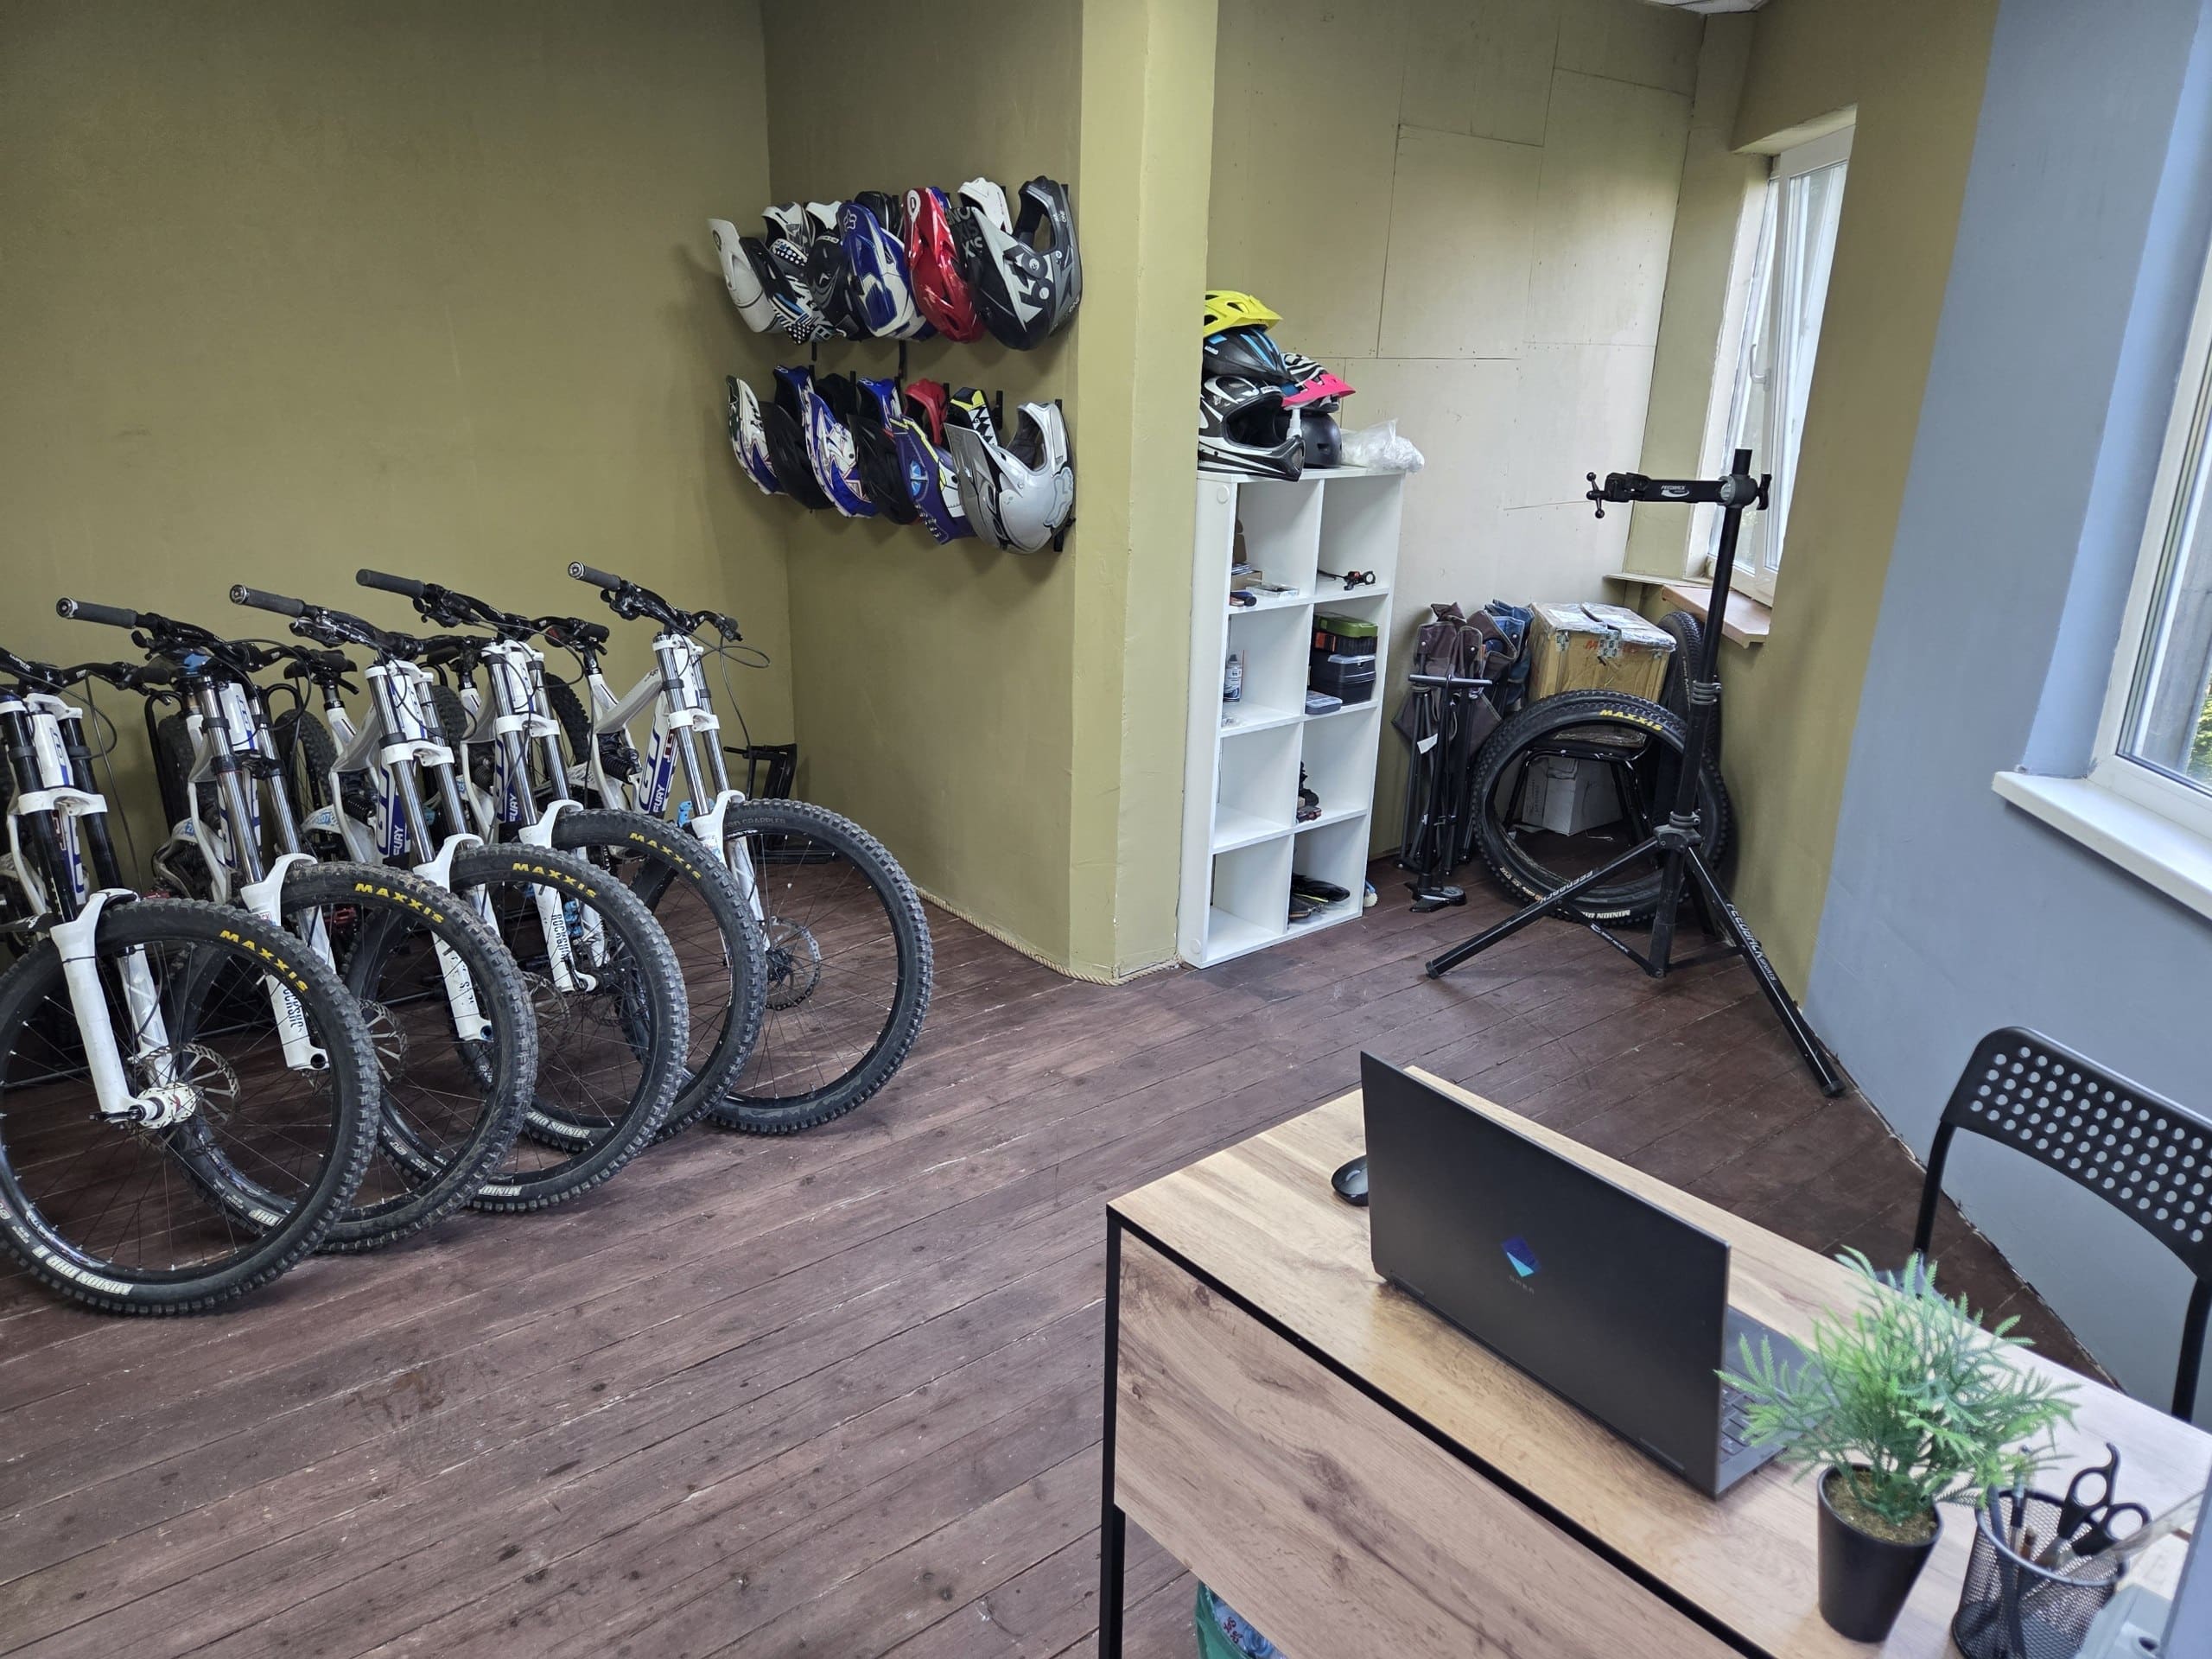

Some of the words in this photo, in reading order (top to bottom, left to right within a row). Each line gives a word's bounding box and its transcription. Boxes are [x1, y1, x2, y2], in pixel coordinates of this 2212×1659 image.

[1599, 709, 1663, 732] MAXXIS
[652, 785, 666, 814] FURY
[629, 832, 702, 880] MAXXIS
[512, 862, 597, 899] MAXXIS
[355, 883, 444, 924] MAXXIS
[1726, 903, 1767, 959] FEEDBACK
[219, 930, 308, 993] MAXXIS
[75, 1271, 134, 1296] MINION
